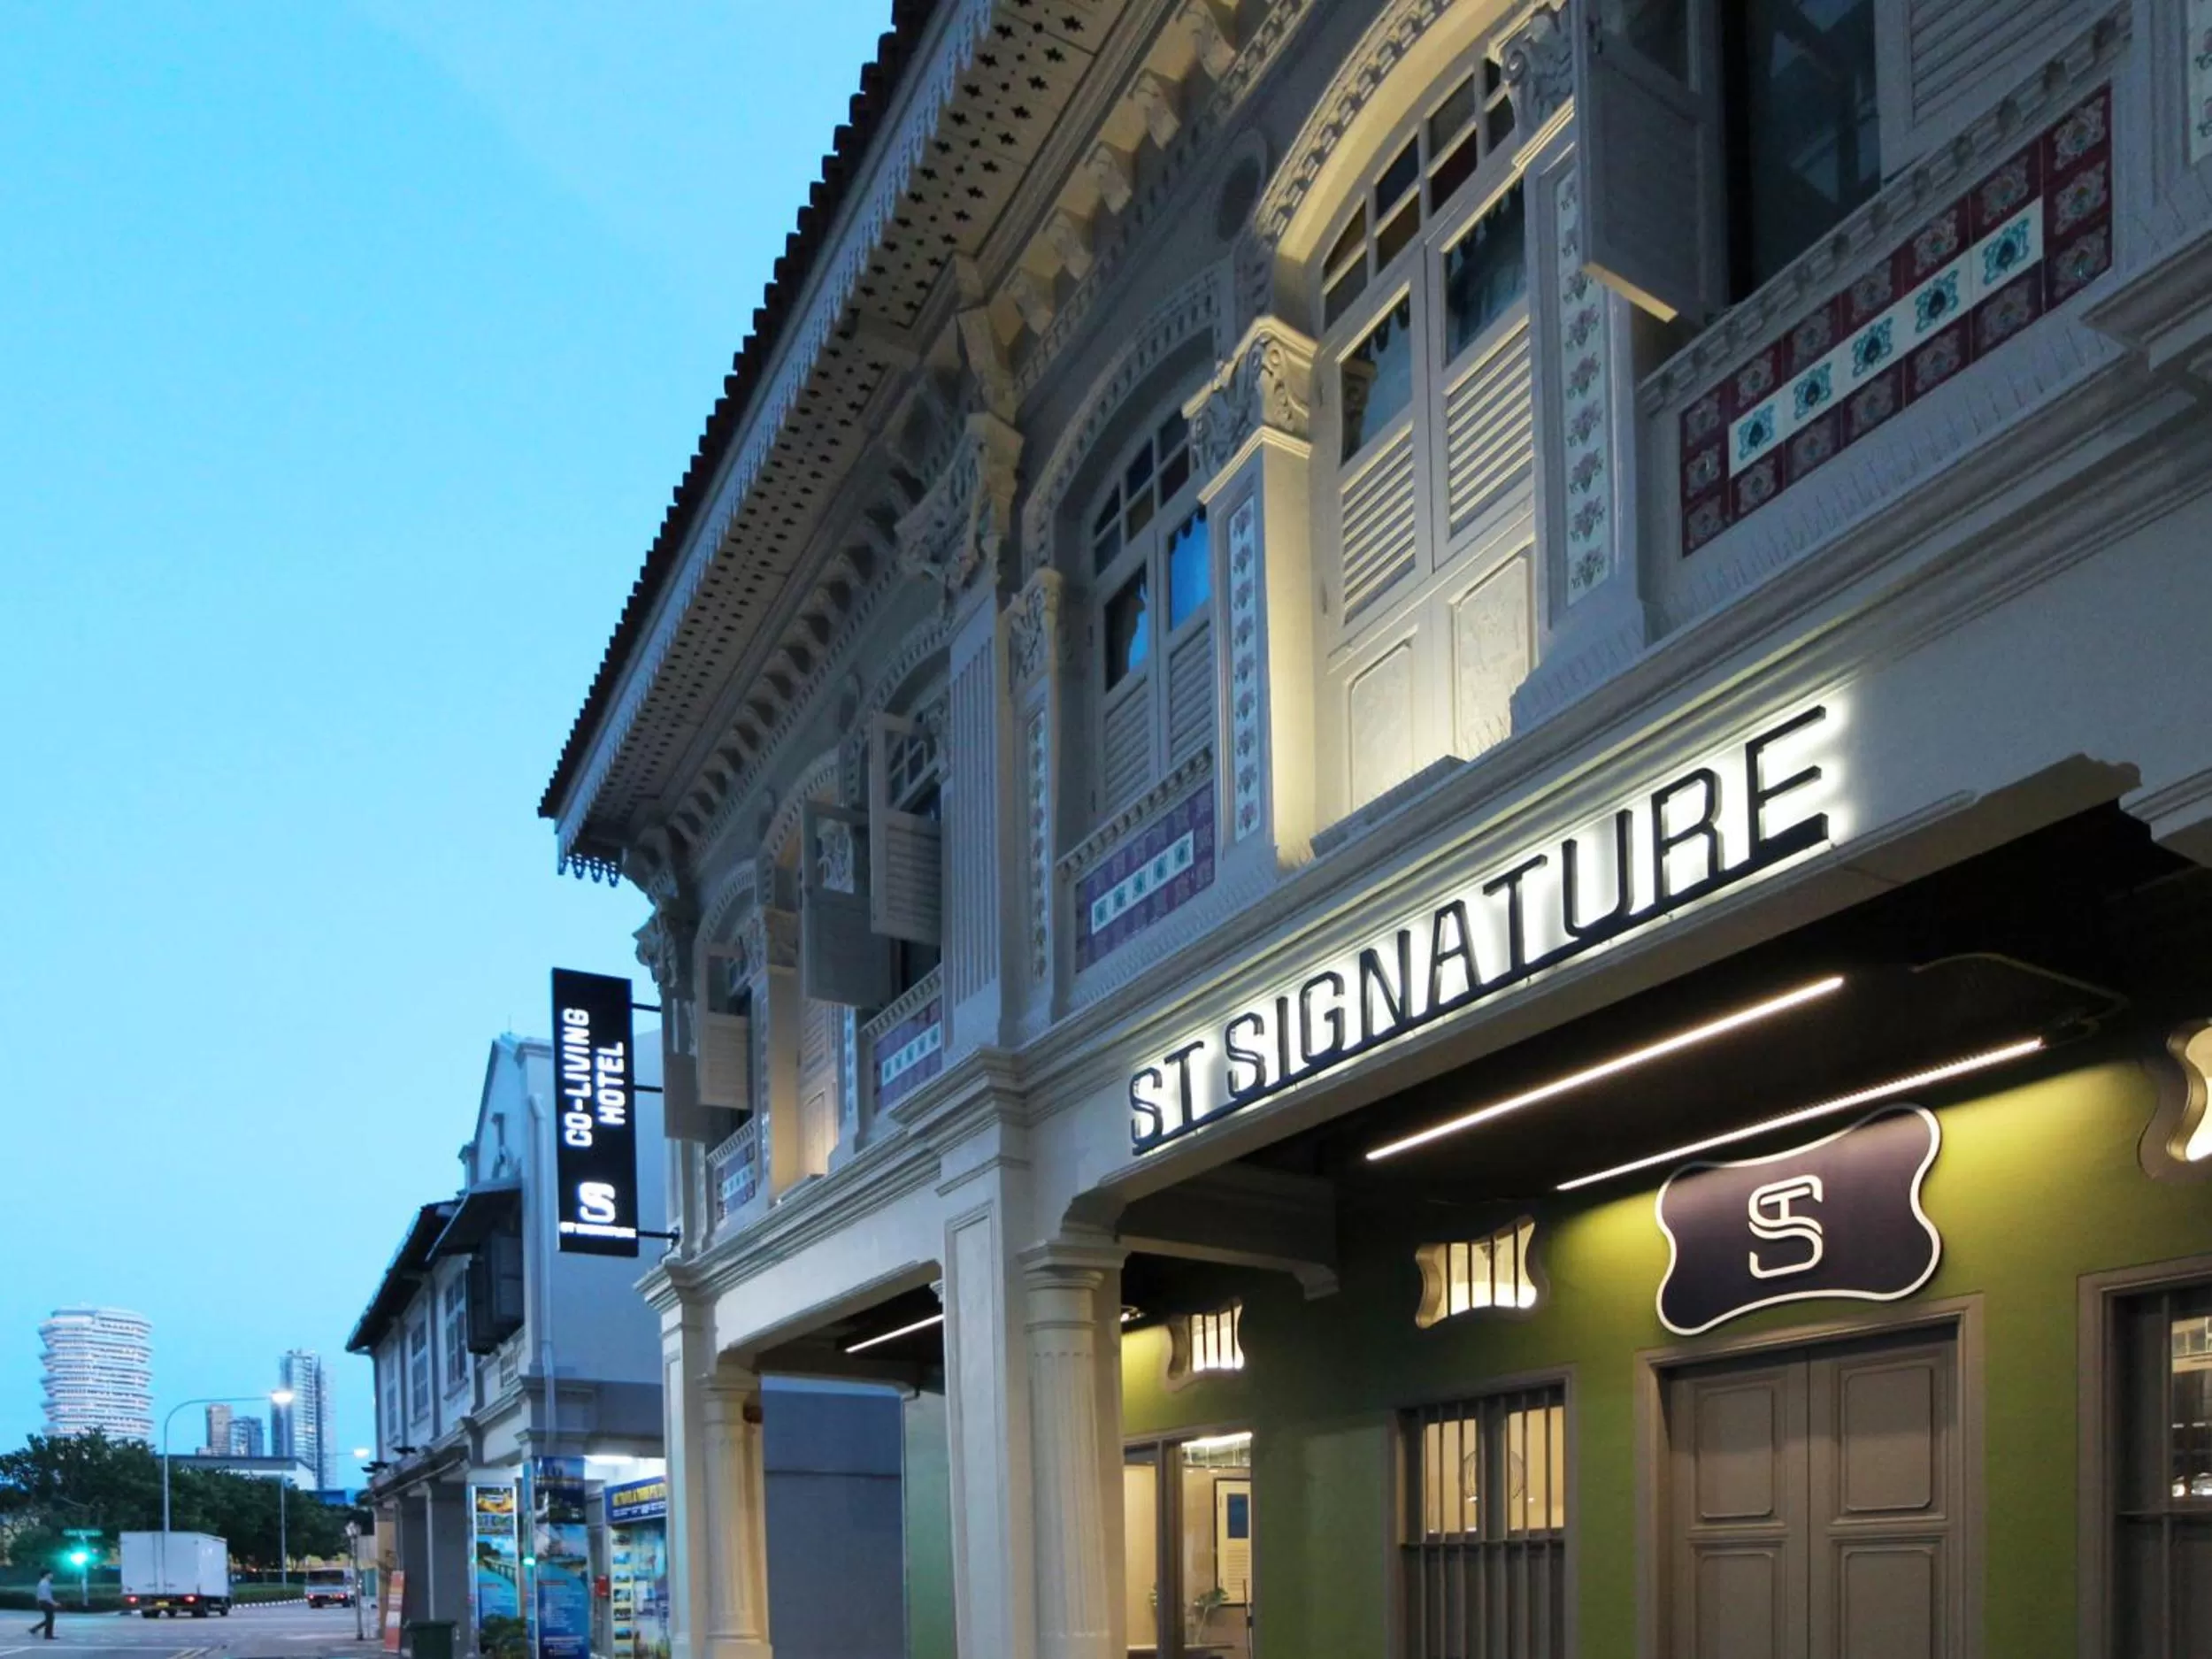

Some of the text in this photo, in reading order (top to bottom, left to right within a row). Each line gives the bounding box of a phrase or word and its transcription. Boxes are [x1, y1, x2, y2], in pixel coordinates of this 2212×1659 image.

[1129, 704, 1828, 1148] ST SIGNATURE
[563, 1007, 593, 1148] CO-LIVING
[596, 1041, 626, 1125] HOTEL
